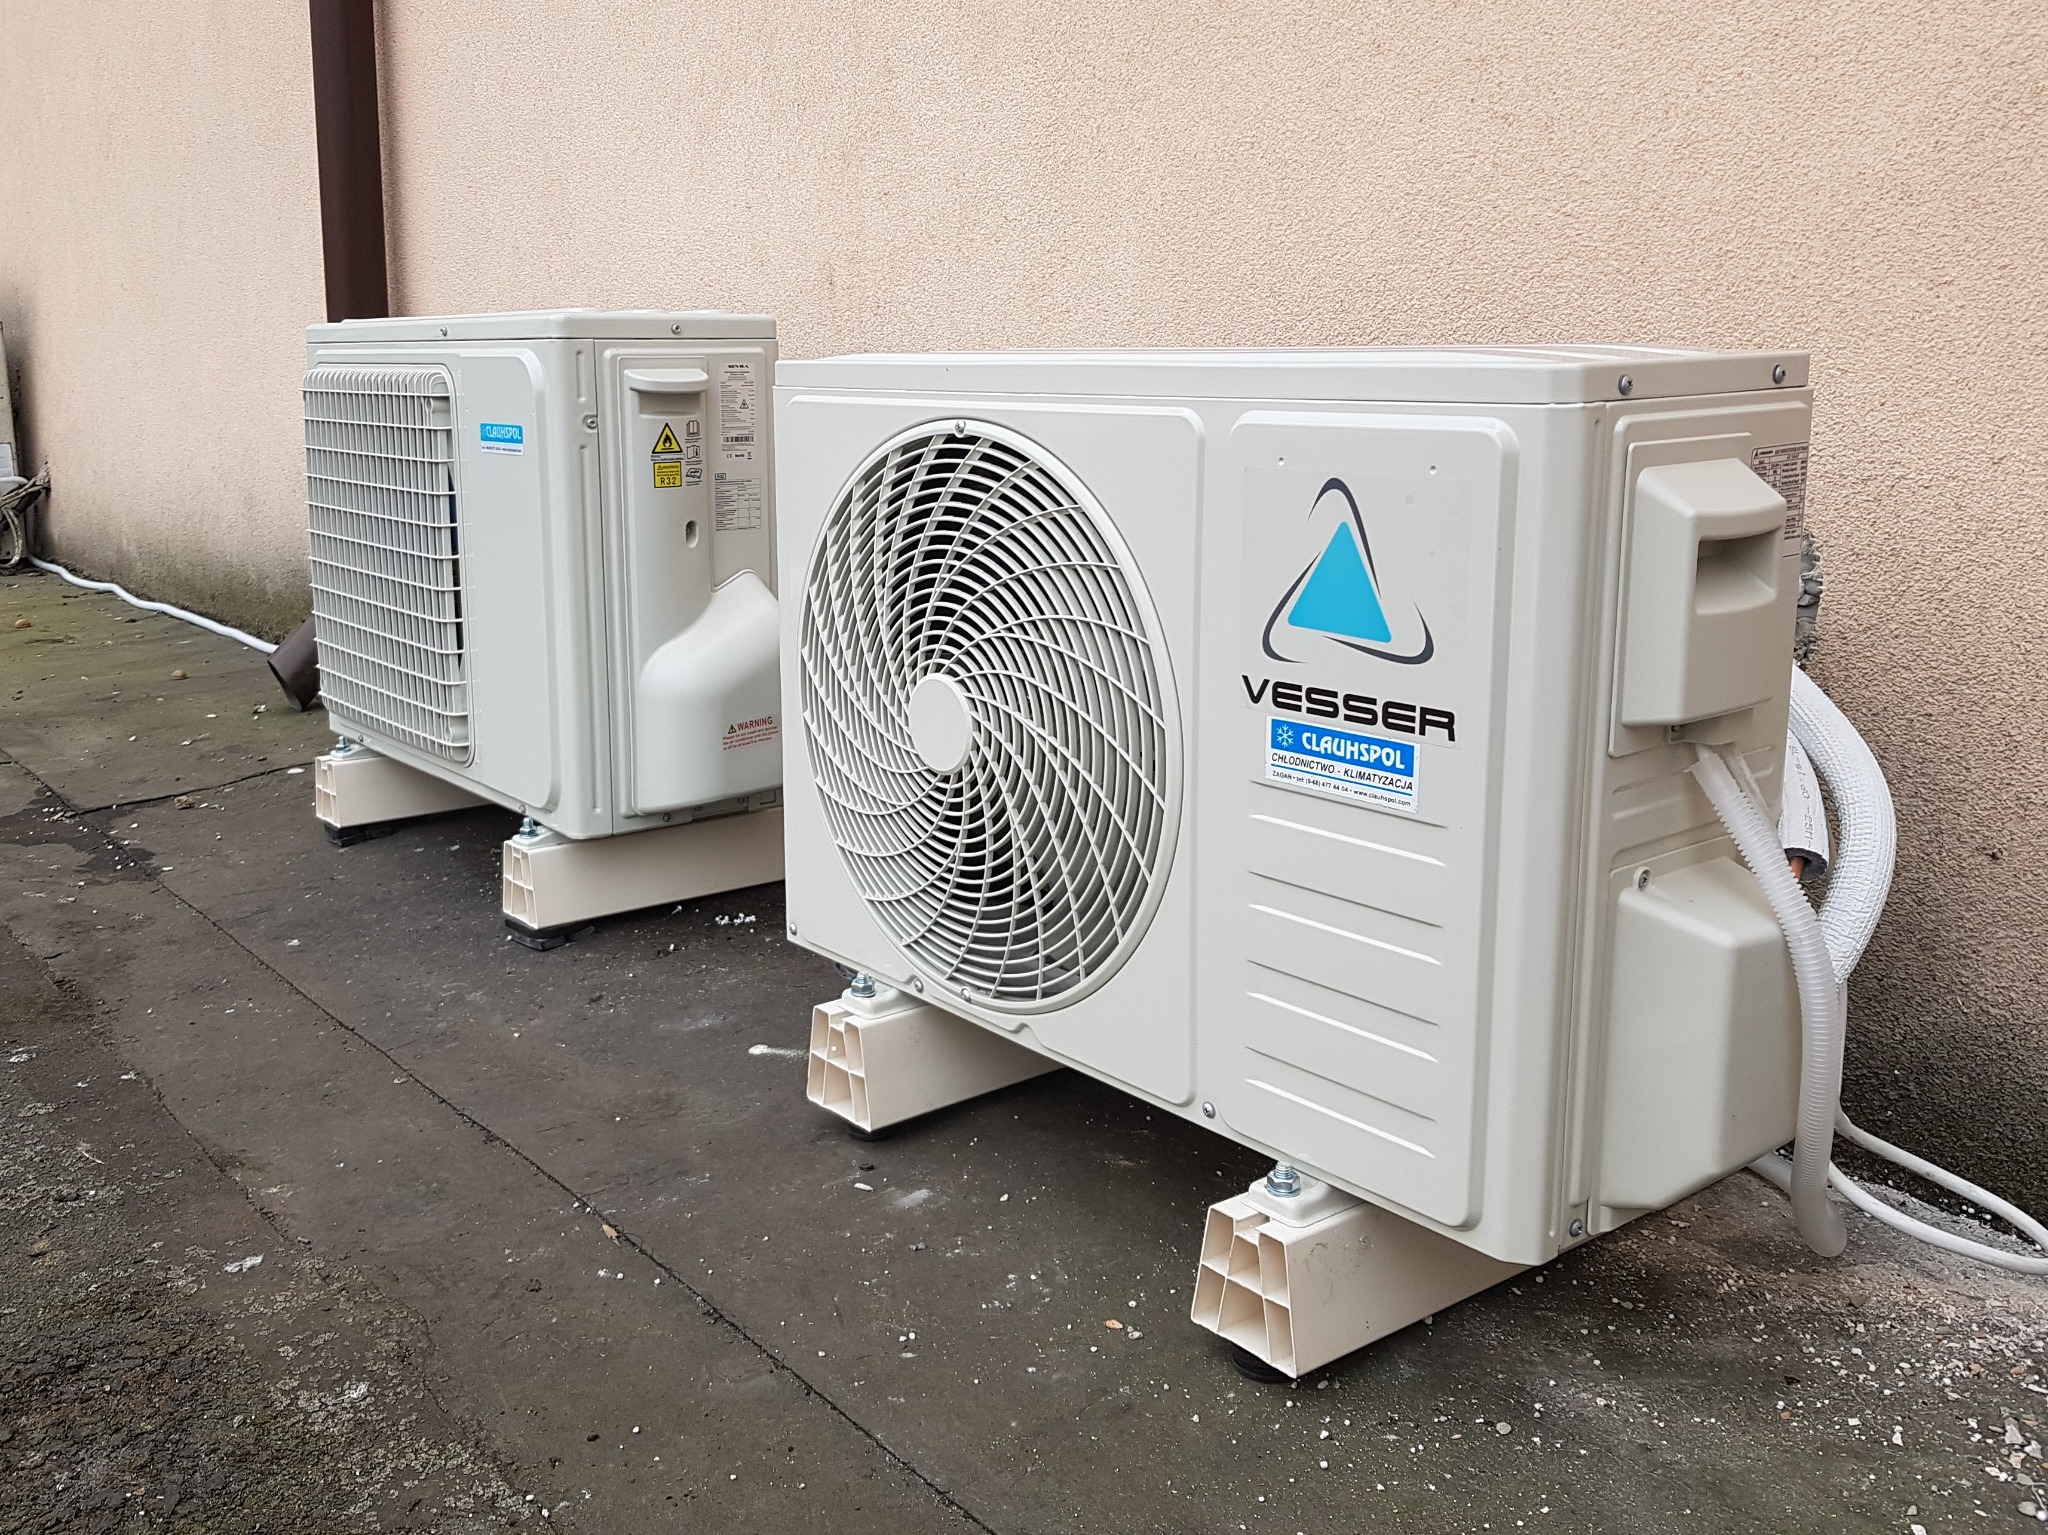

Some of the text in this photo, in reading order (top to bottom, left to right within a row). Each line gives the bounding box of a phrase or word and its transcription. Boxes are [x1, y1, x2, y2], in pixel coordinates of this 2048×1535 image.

[486, 425, 522, 440] CLAUHSPOL
[660, 476, 677, 485] R32
[1242, 675, 1456, 742] VESSER
[737, 716, 773, 731] WARNING
[1302, 732, 1405, 769] CLAUHSPOL
[1271, 752, 1335, 774] CHŁODNICTWO
[1343, 767, 1413, 791] KLIMATYZACJA
[1321, 780, 1332, 789] 477
[1333, 783, 1340, 791] 44
